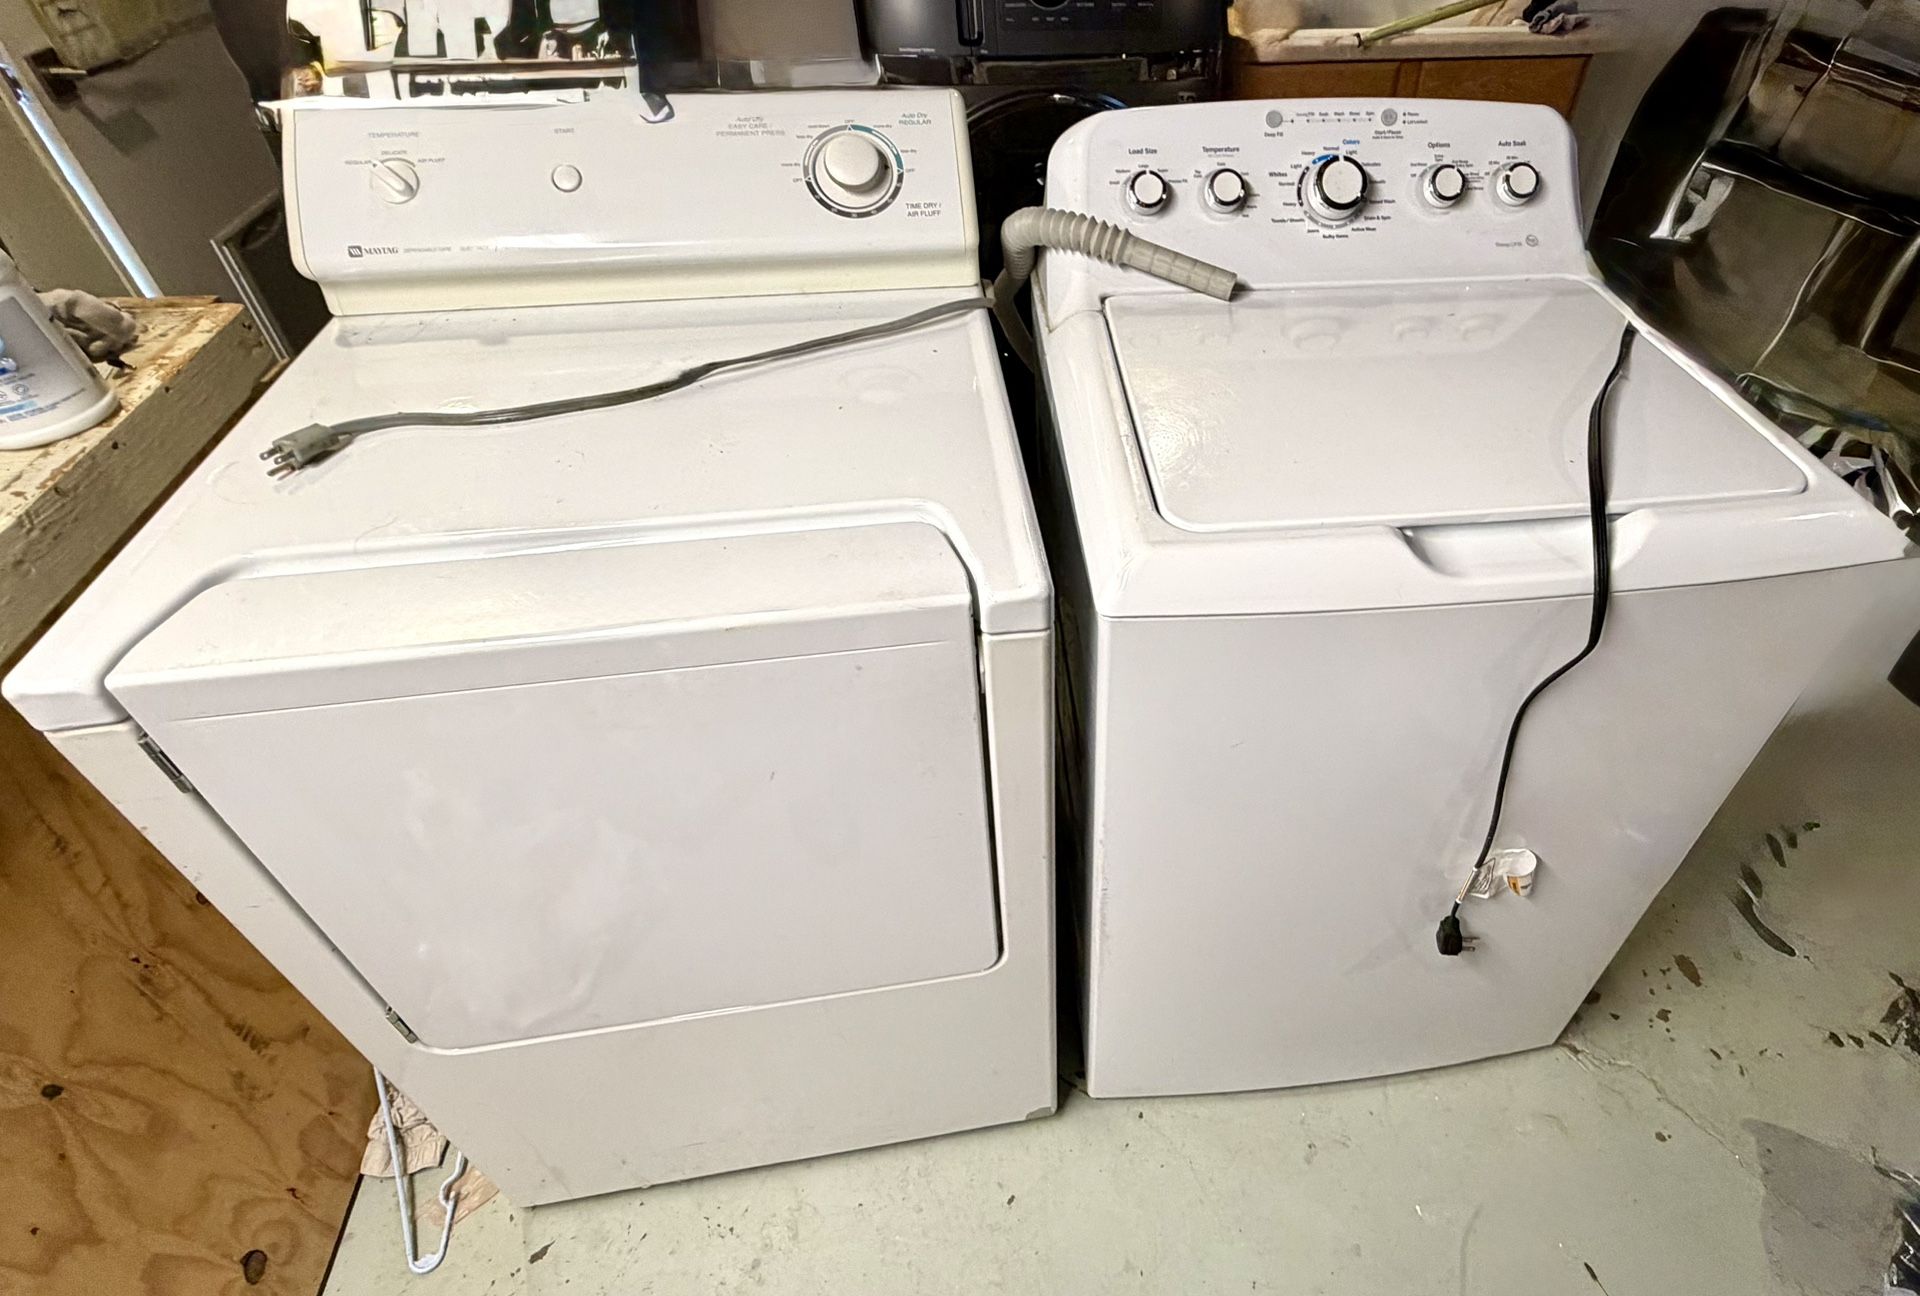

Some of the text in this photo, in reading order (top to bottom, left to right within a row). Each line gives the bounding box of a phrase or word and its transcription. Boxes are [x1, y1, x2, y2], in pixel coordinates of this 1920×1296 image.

[917, 112, 928, 120] Dry
[898, 118, 932, 126] REGULAR
[1202, 146, 1240, 154] Temperature
[920, 209, 941, 217] FLUFF
[364, 246, 399, 255] MAYTAG
